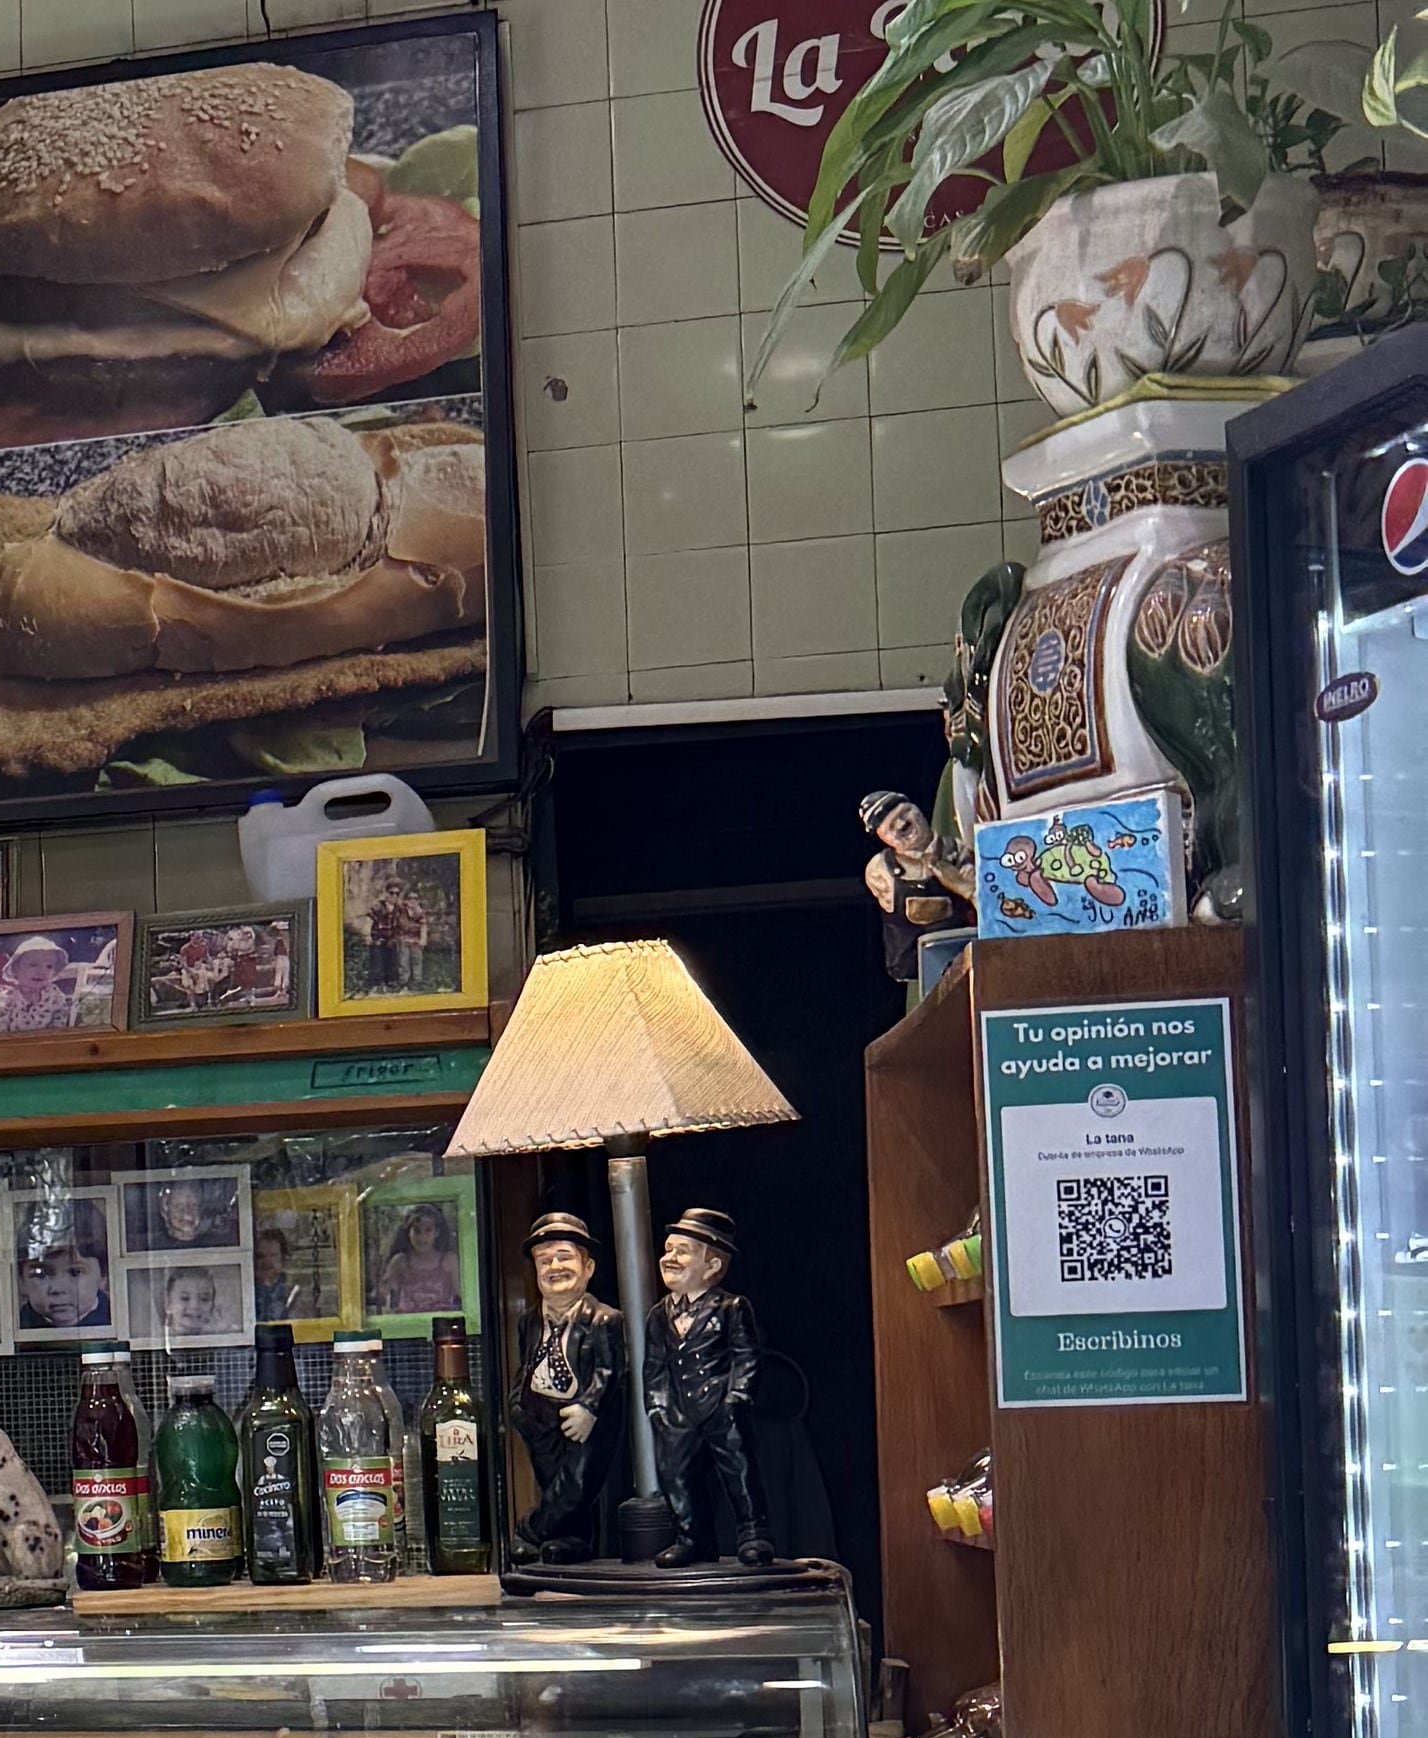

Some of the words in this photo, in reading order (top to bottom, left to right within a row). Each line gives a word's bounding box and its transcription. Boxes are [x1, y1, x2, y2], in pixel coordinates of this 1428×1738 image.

[732, 18, 843, 127] La
[1013, 1022, 1043, 1043] Tu
[1050, 1018, 1145, 1047] opinión
[1152, 1020, 1195, 1036] nos
[1001, 1051, 1080, 1079] ayuda
[1087, 1053, 1103, 1070] a
[1110, 1048, 1212, 1072] mejorar
[1086, 1134, 1102, 1145] La
[1106, 1134, 1134, 1143] tana
[1057, 1331, 1182, 1352] Escribinos
